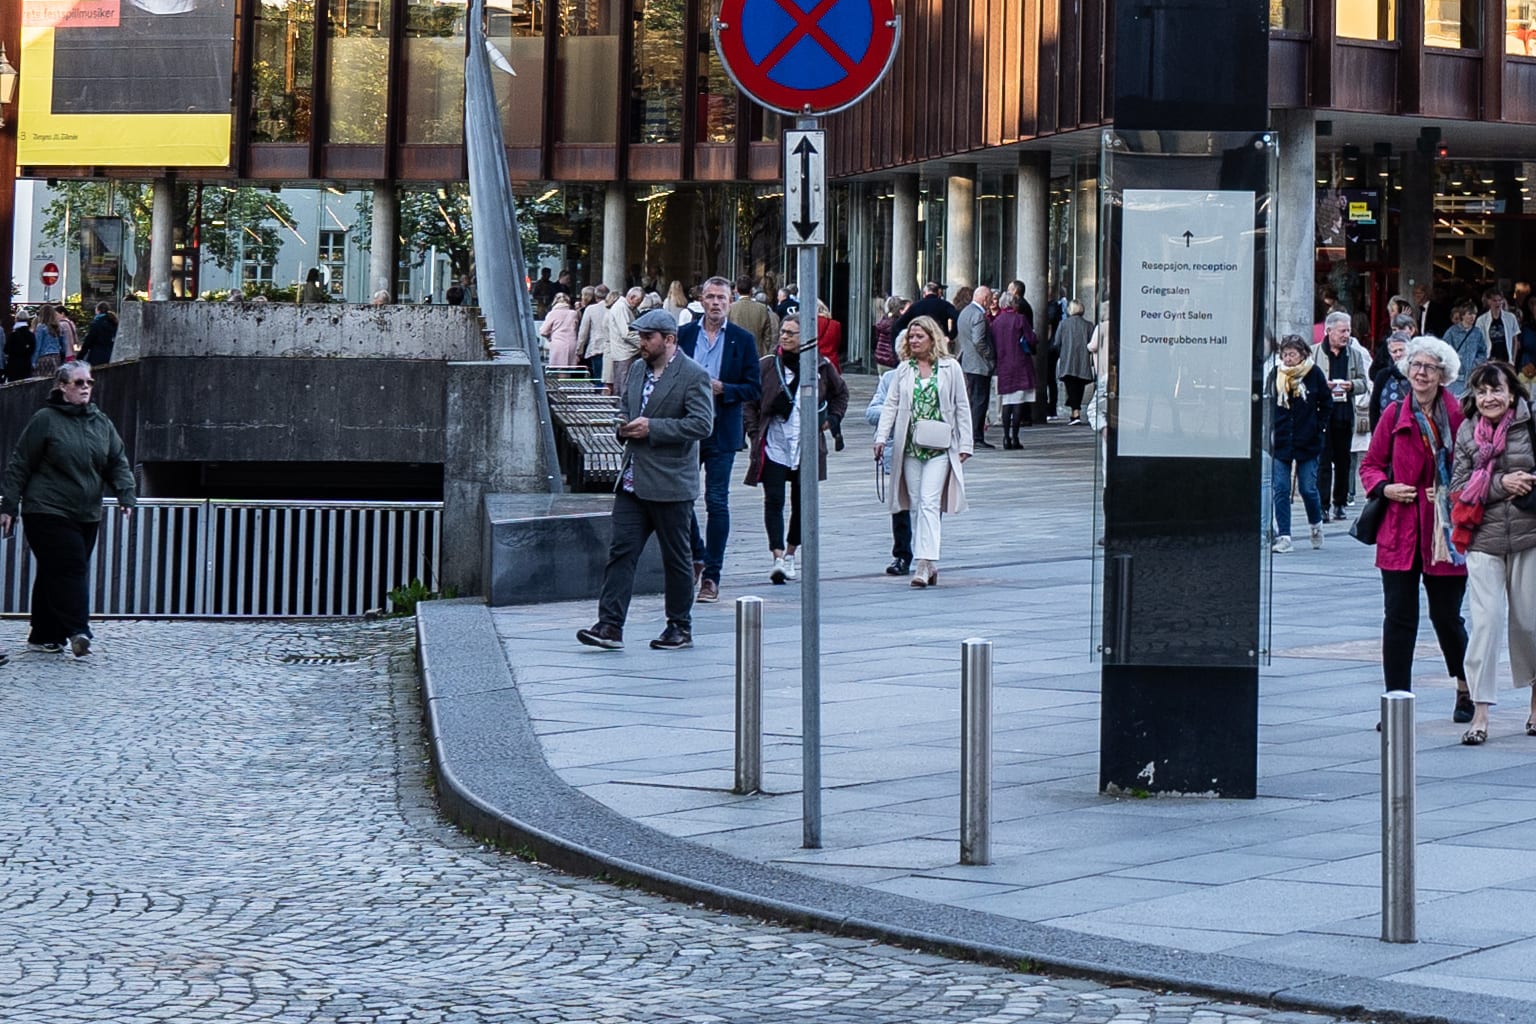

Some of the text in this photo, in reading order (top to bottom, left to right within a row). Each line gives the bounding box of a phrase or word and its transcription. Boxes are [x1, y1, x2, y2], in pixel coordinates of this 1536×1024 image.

[1141, 261, 1238, 272] Resepsjon, reception
[1141, 285, 1190, 296] Griegsalen
[1140, 310, 1213, 321] Peer Gynt Salen
[1140, 335, 1228, 346] Dovregubbens Hall
